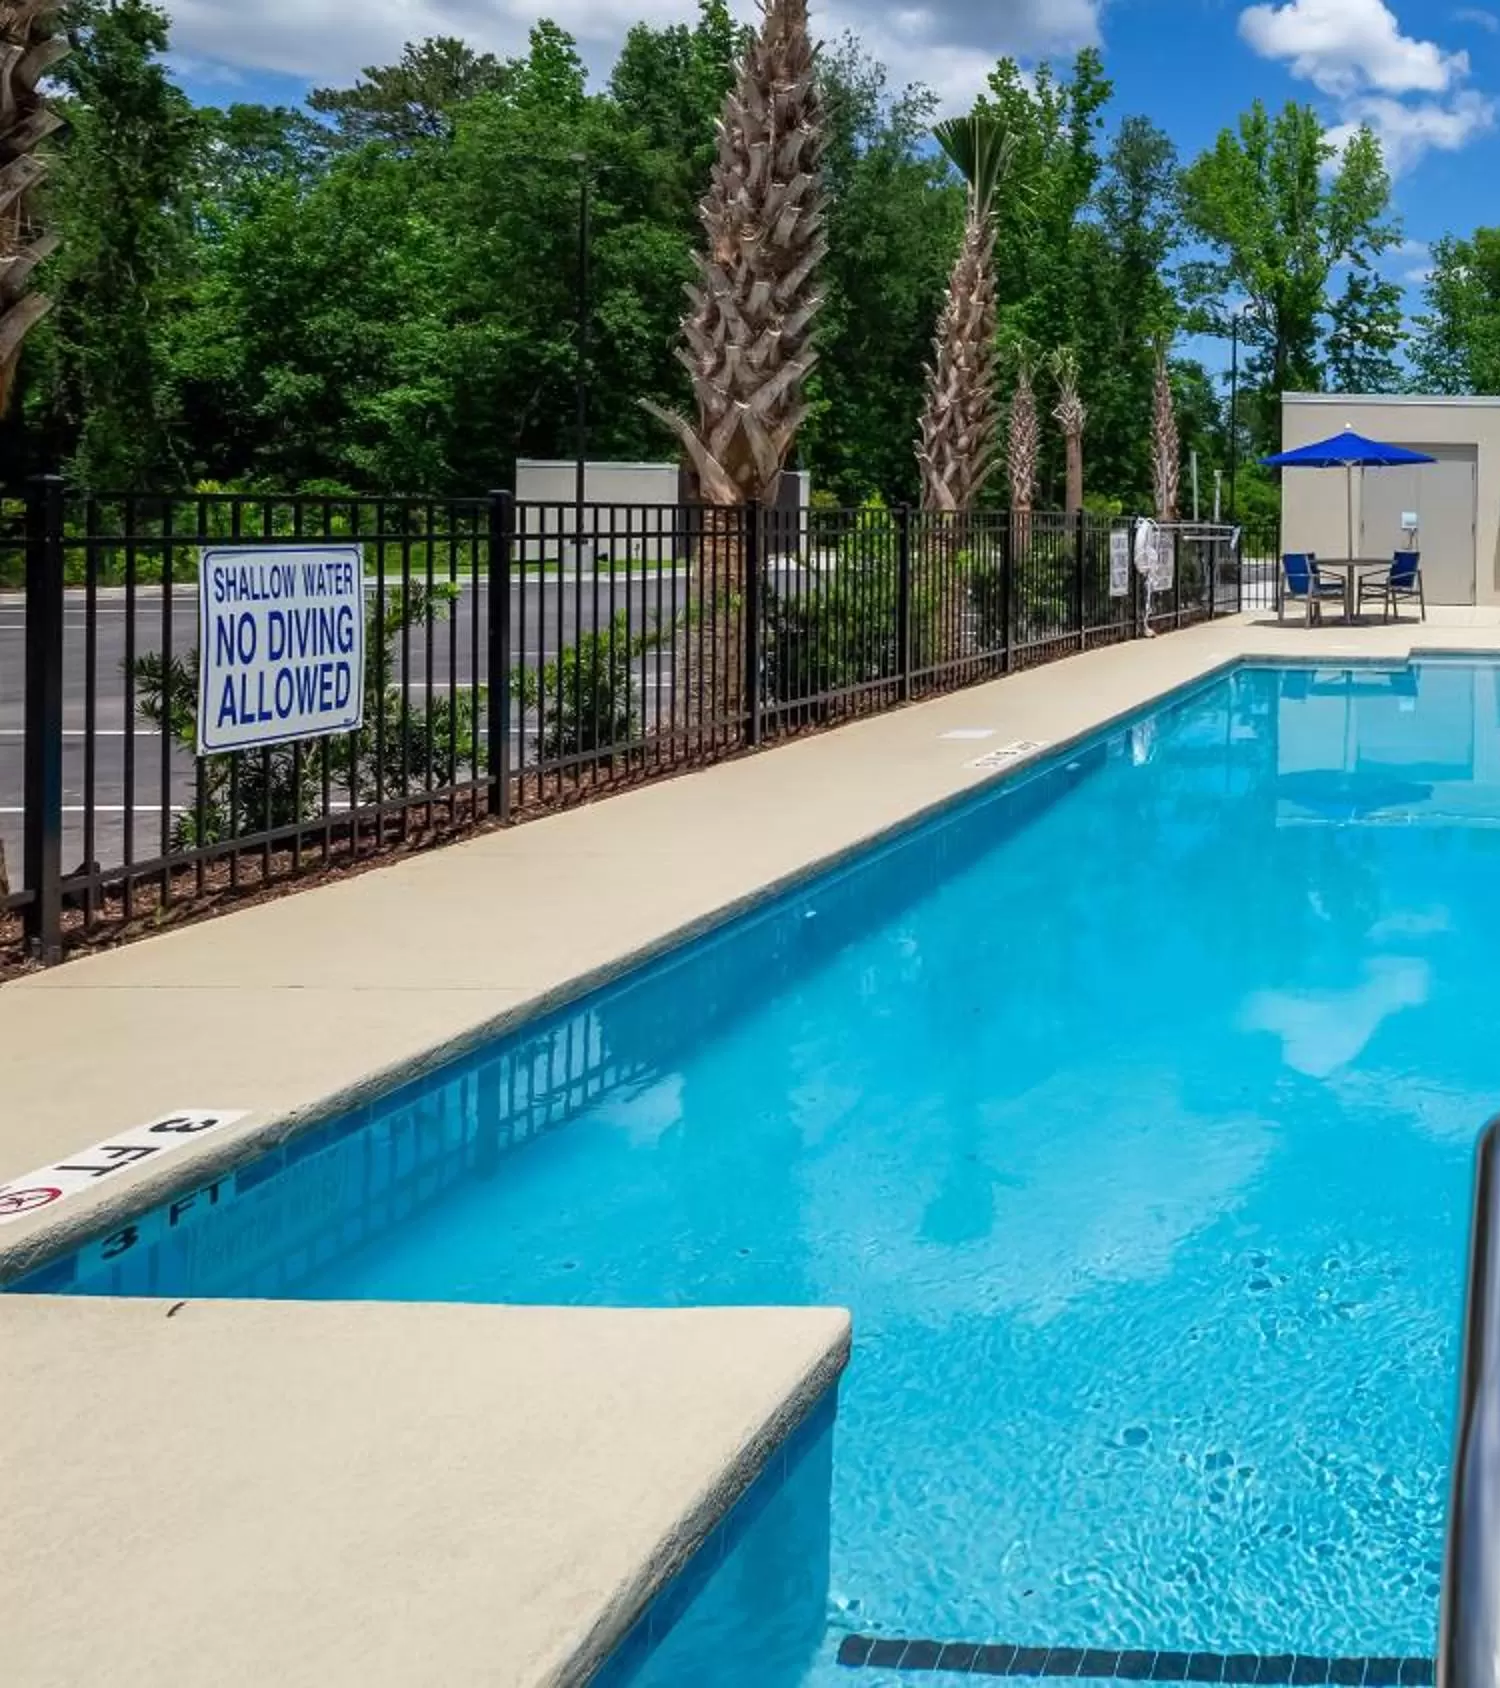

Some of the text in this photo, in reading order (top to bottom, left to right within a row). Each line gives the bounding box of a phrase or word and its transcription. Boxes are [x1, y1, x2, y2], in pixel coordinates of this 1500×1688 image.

[213, 562, 353, 603] SHALLOW WATER
[216, 605, 353, 668] NO DIVING
[217, 661, 351, 728] ALLOWED
[53, 1116, 219, 1177] 3 FT
[101, 1177, 232, 1260] 3 FT
